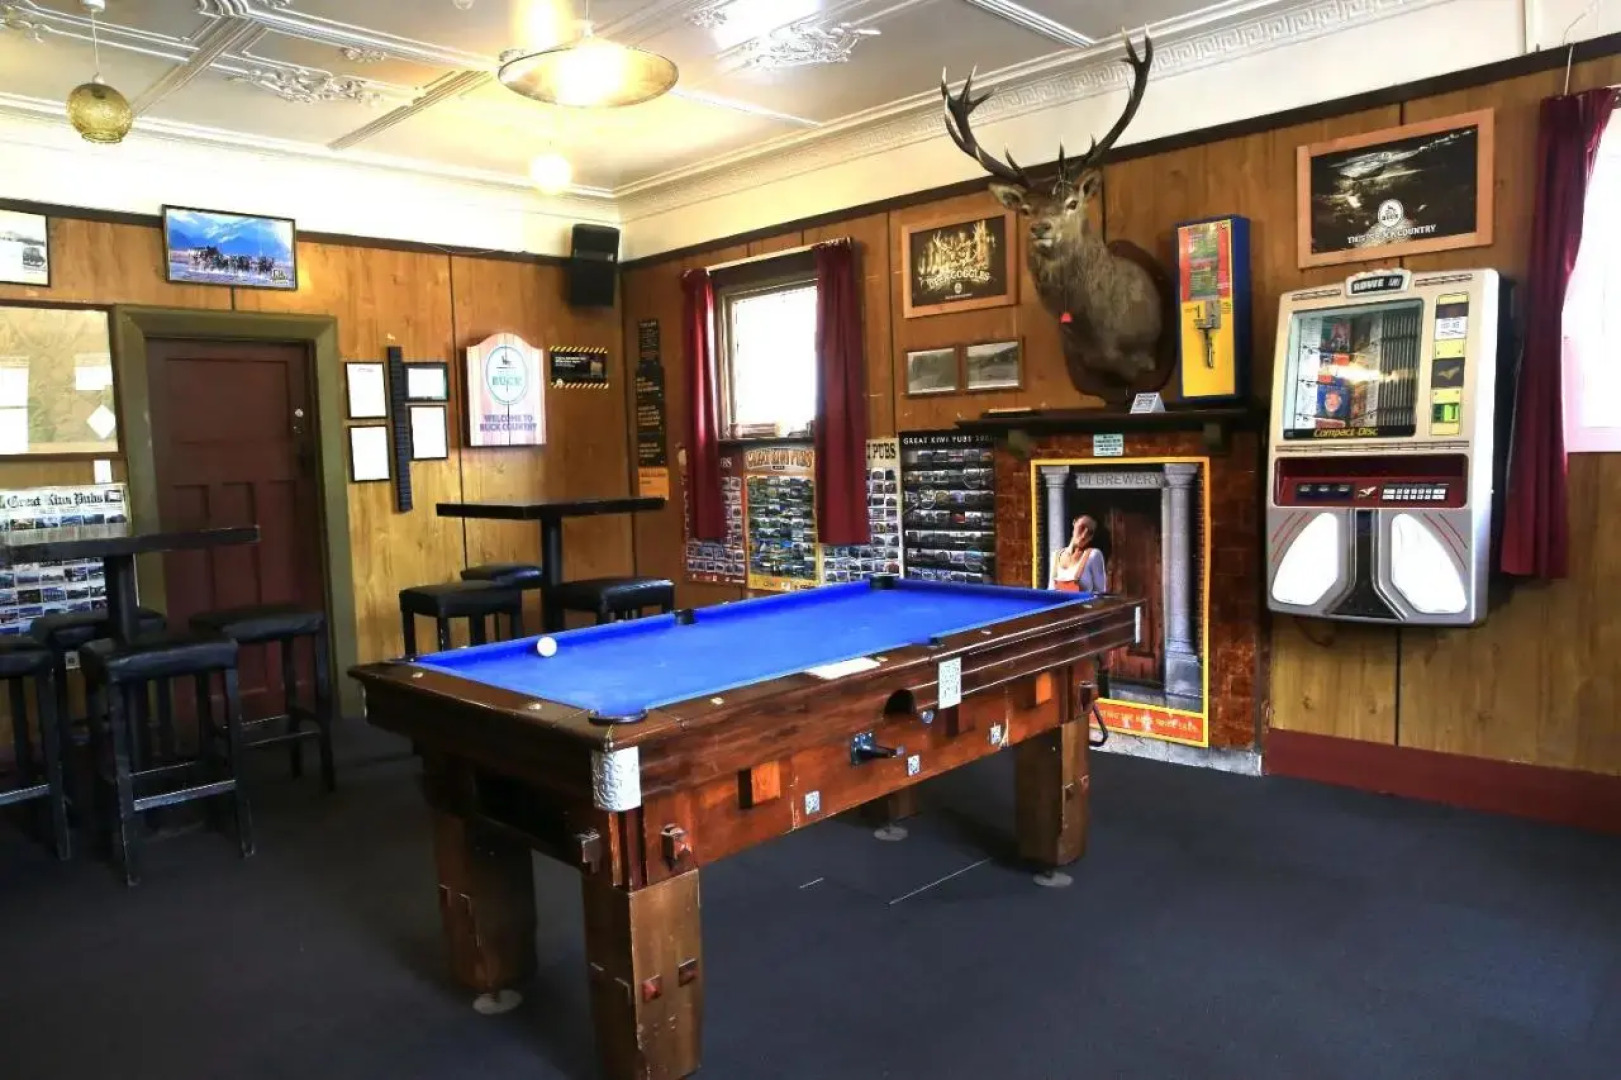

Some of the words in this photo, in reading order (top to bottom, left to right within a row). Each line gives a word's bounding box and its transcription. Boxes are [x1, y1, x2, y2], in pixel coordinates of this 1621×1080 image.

[1397, 224, 1437, 237] COUNTRY
[1353, 279, 1385, 291] ROWE
[484, 414, 520, 423] WELCOME
[523, 414, 533, 422] TO
[480, 423, 500, 433] BUCK
[502, 422, 537, 432] COUNTRY
[1313, 427, 1355, 438] Compact
[902, 437, 927, 445] GREAT
[872, 442, 896, 459] PUBS
